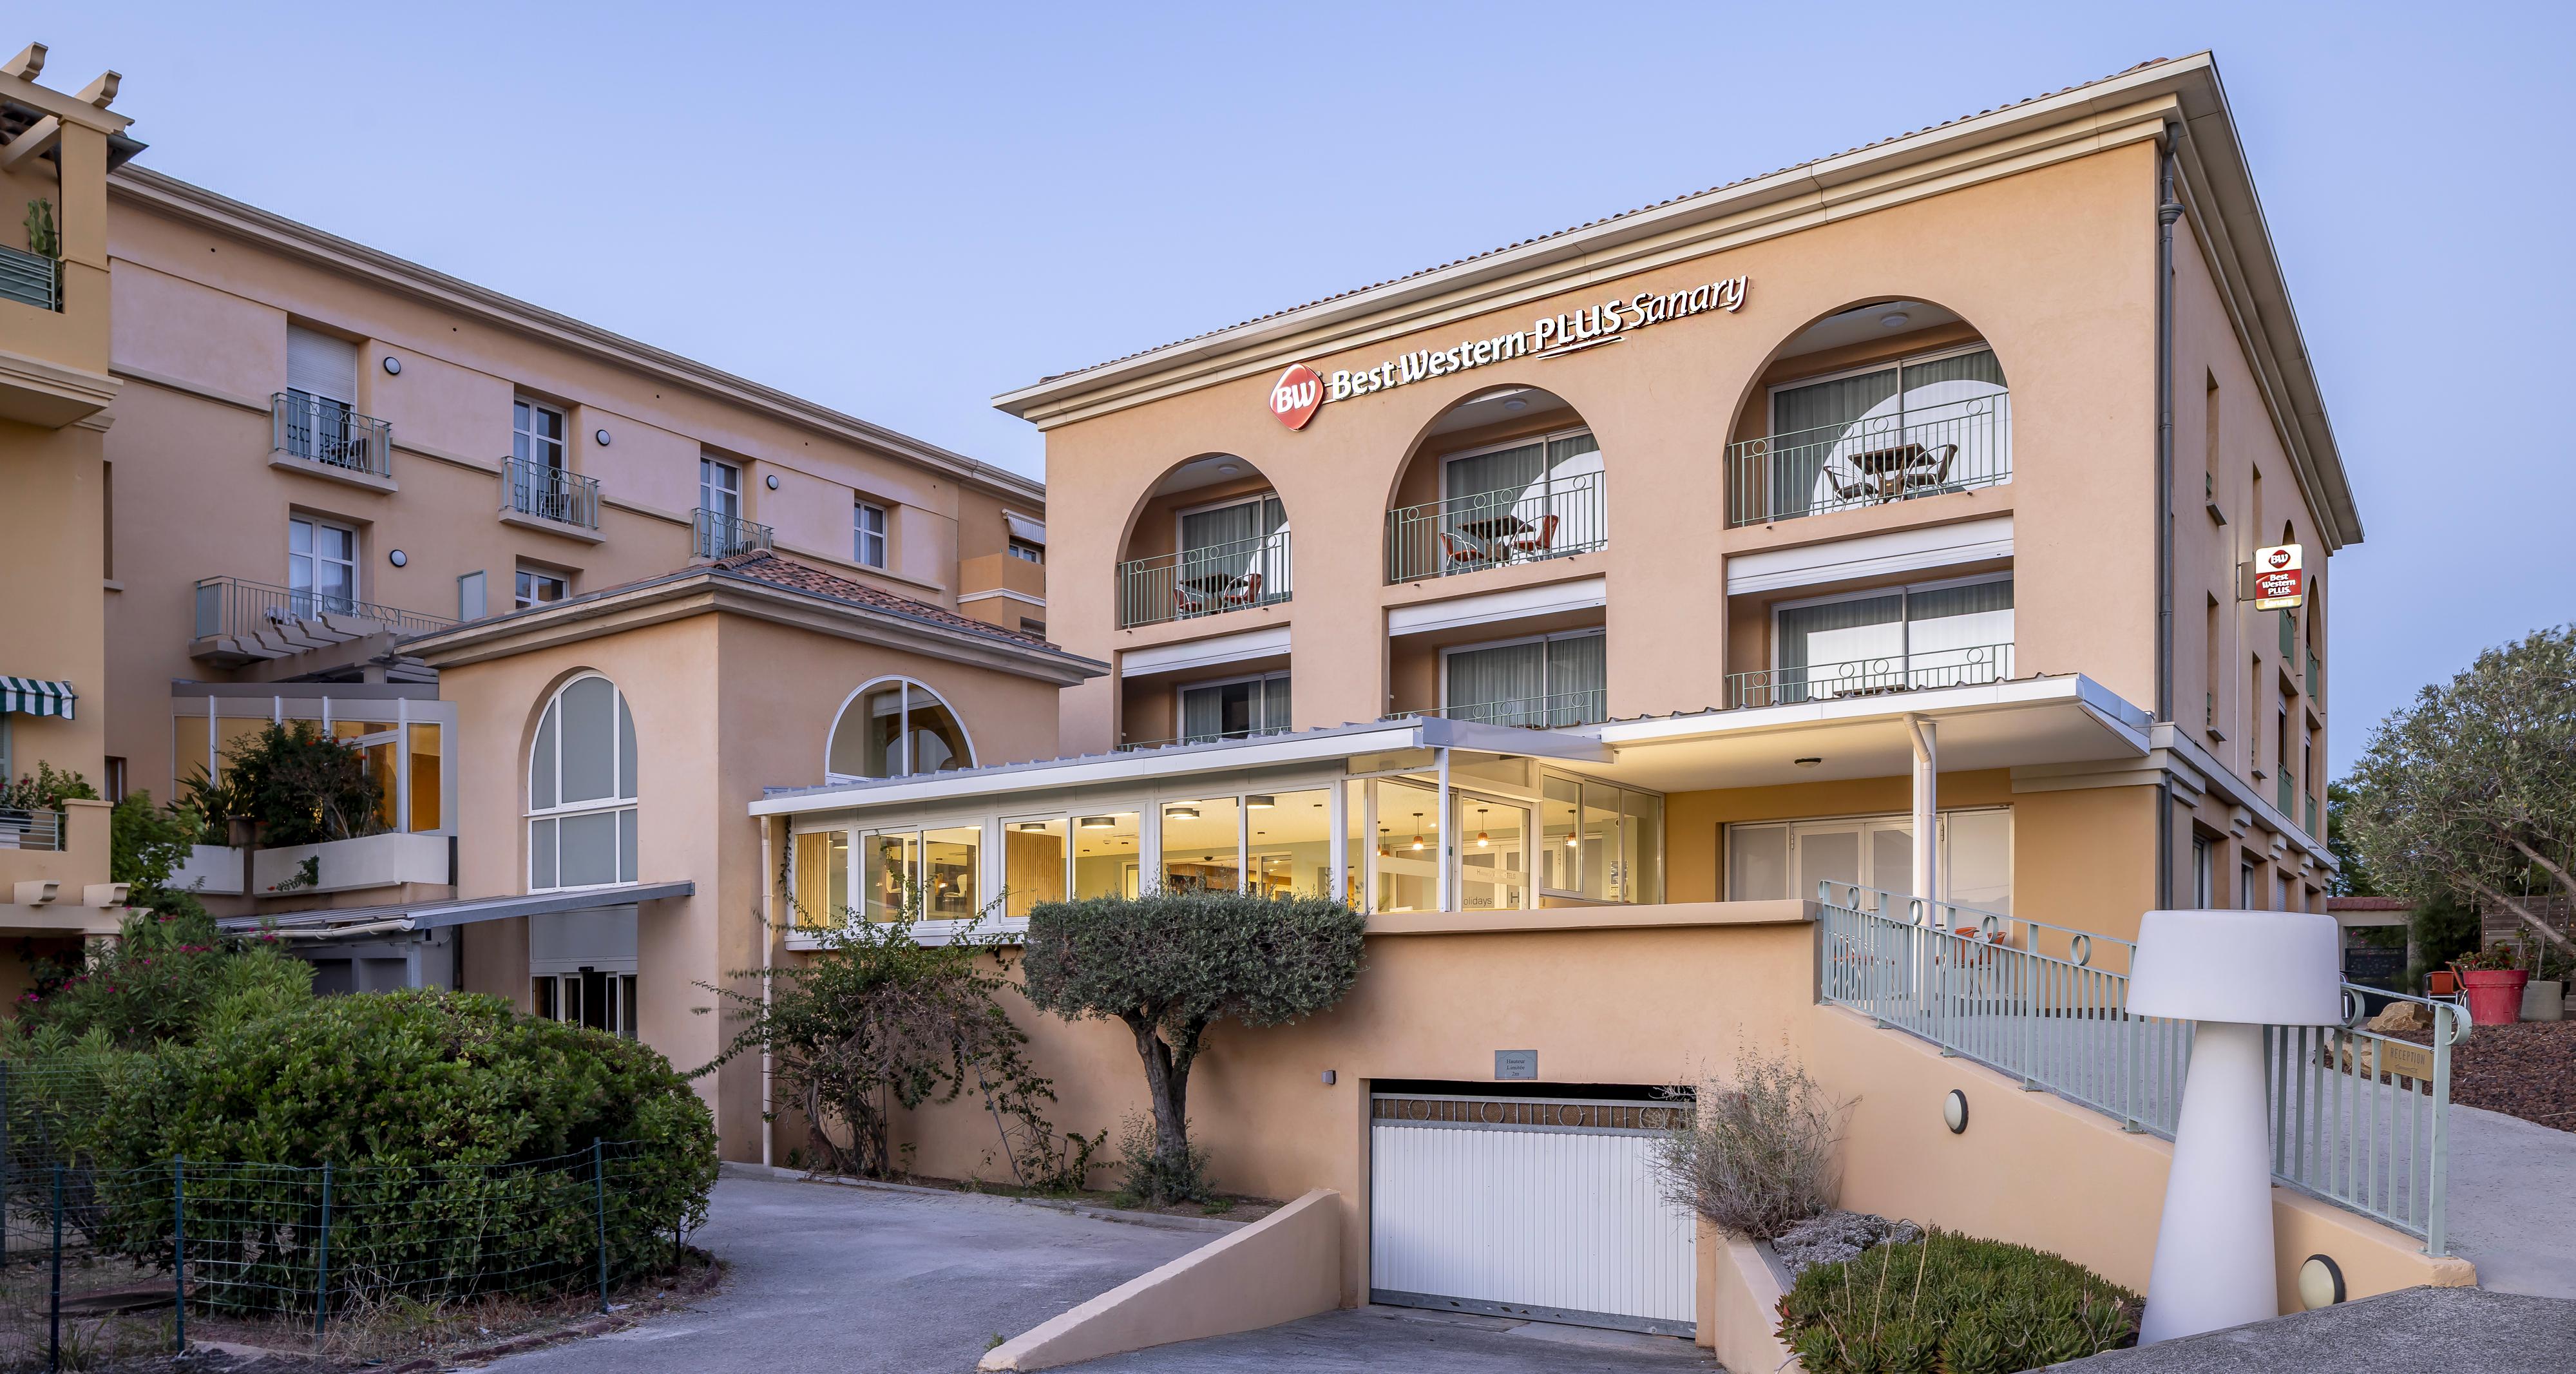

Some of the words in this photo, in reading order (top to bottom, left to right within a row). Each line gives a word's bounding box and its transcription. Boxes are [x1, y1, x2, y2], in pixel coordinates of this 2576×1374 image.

[1331, 360, 1398, 401] Best
[1398, 329, 1529, 383] Western
[1535, 299, 1625, 350] PLUS
[1628, 274, 1748, 329] Sanary
[1276, 379, 1316, 414] BW
[2270, 553, 2289, 564] BW
[2270, 573, 2289, 582] Best
[2262, 579, 2296, 589] Western
[1463, 896, 1493, 907] olidays
[2390, 1047, 2426, 1065] RECEPTION
